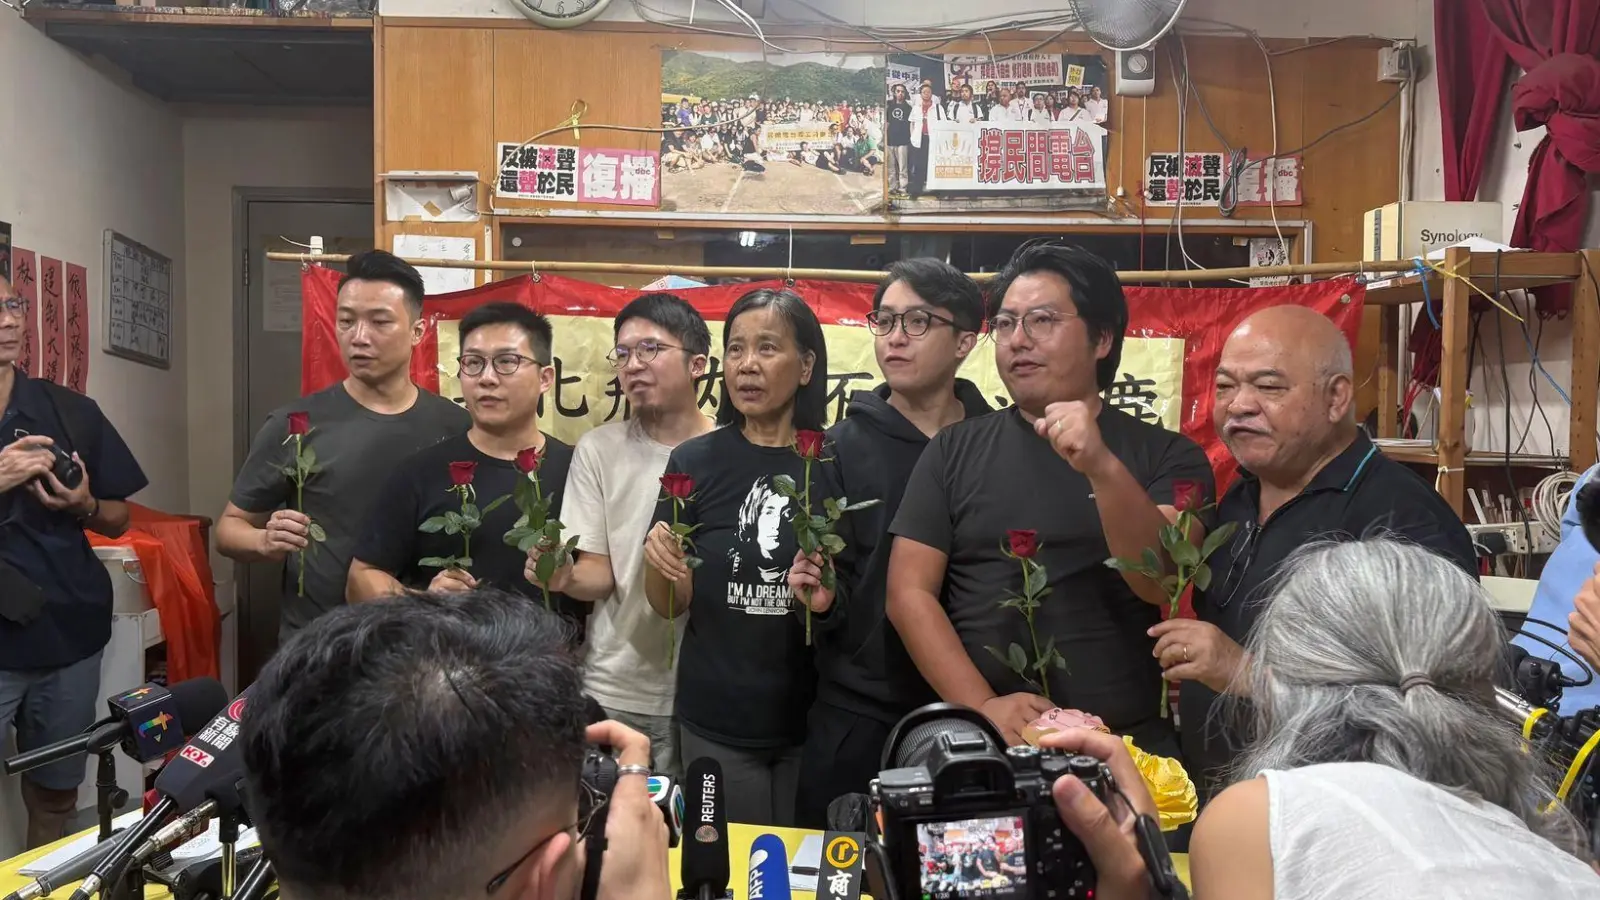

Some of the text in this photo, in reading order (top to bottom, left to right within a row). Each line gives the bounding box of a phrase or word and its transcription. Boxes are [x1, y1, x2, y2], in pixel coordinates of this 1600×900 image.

[500, 145, 576, 171] 反被滅聲
[1149, 155, 1221, 177] 反被滅聲
[500, 170, 575, 195] 還聲於民
[583, 153, 656, 200] 復播
[1278, 169, 1293, 177] dbc
[1149, 179, 1221, 201] 還聲於民
[727, 595, 792, 607] BUT I'M NOT THE ONLY
[728, 582, 744, 596] I'M
[746, 584, 753, 597] A
[212, 716, 240, 739] 有線
[198, 728, 233, 751] 新聞
[182, 746, 208, 763] HOY
[701, 773, 715, 823] REUTERS
[749, 868, 763, 899] AFP
[827, 870, 853, 900] 商
